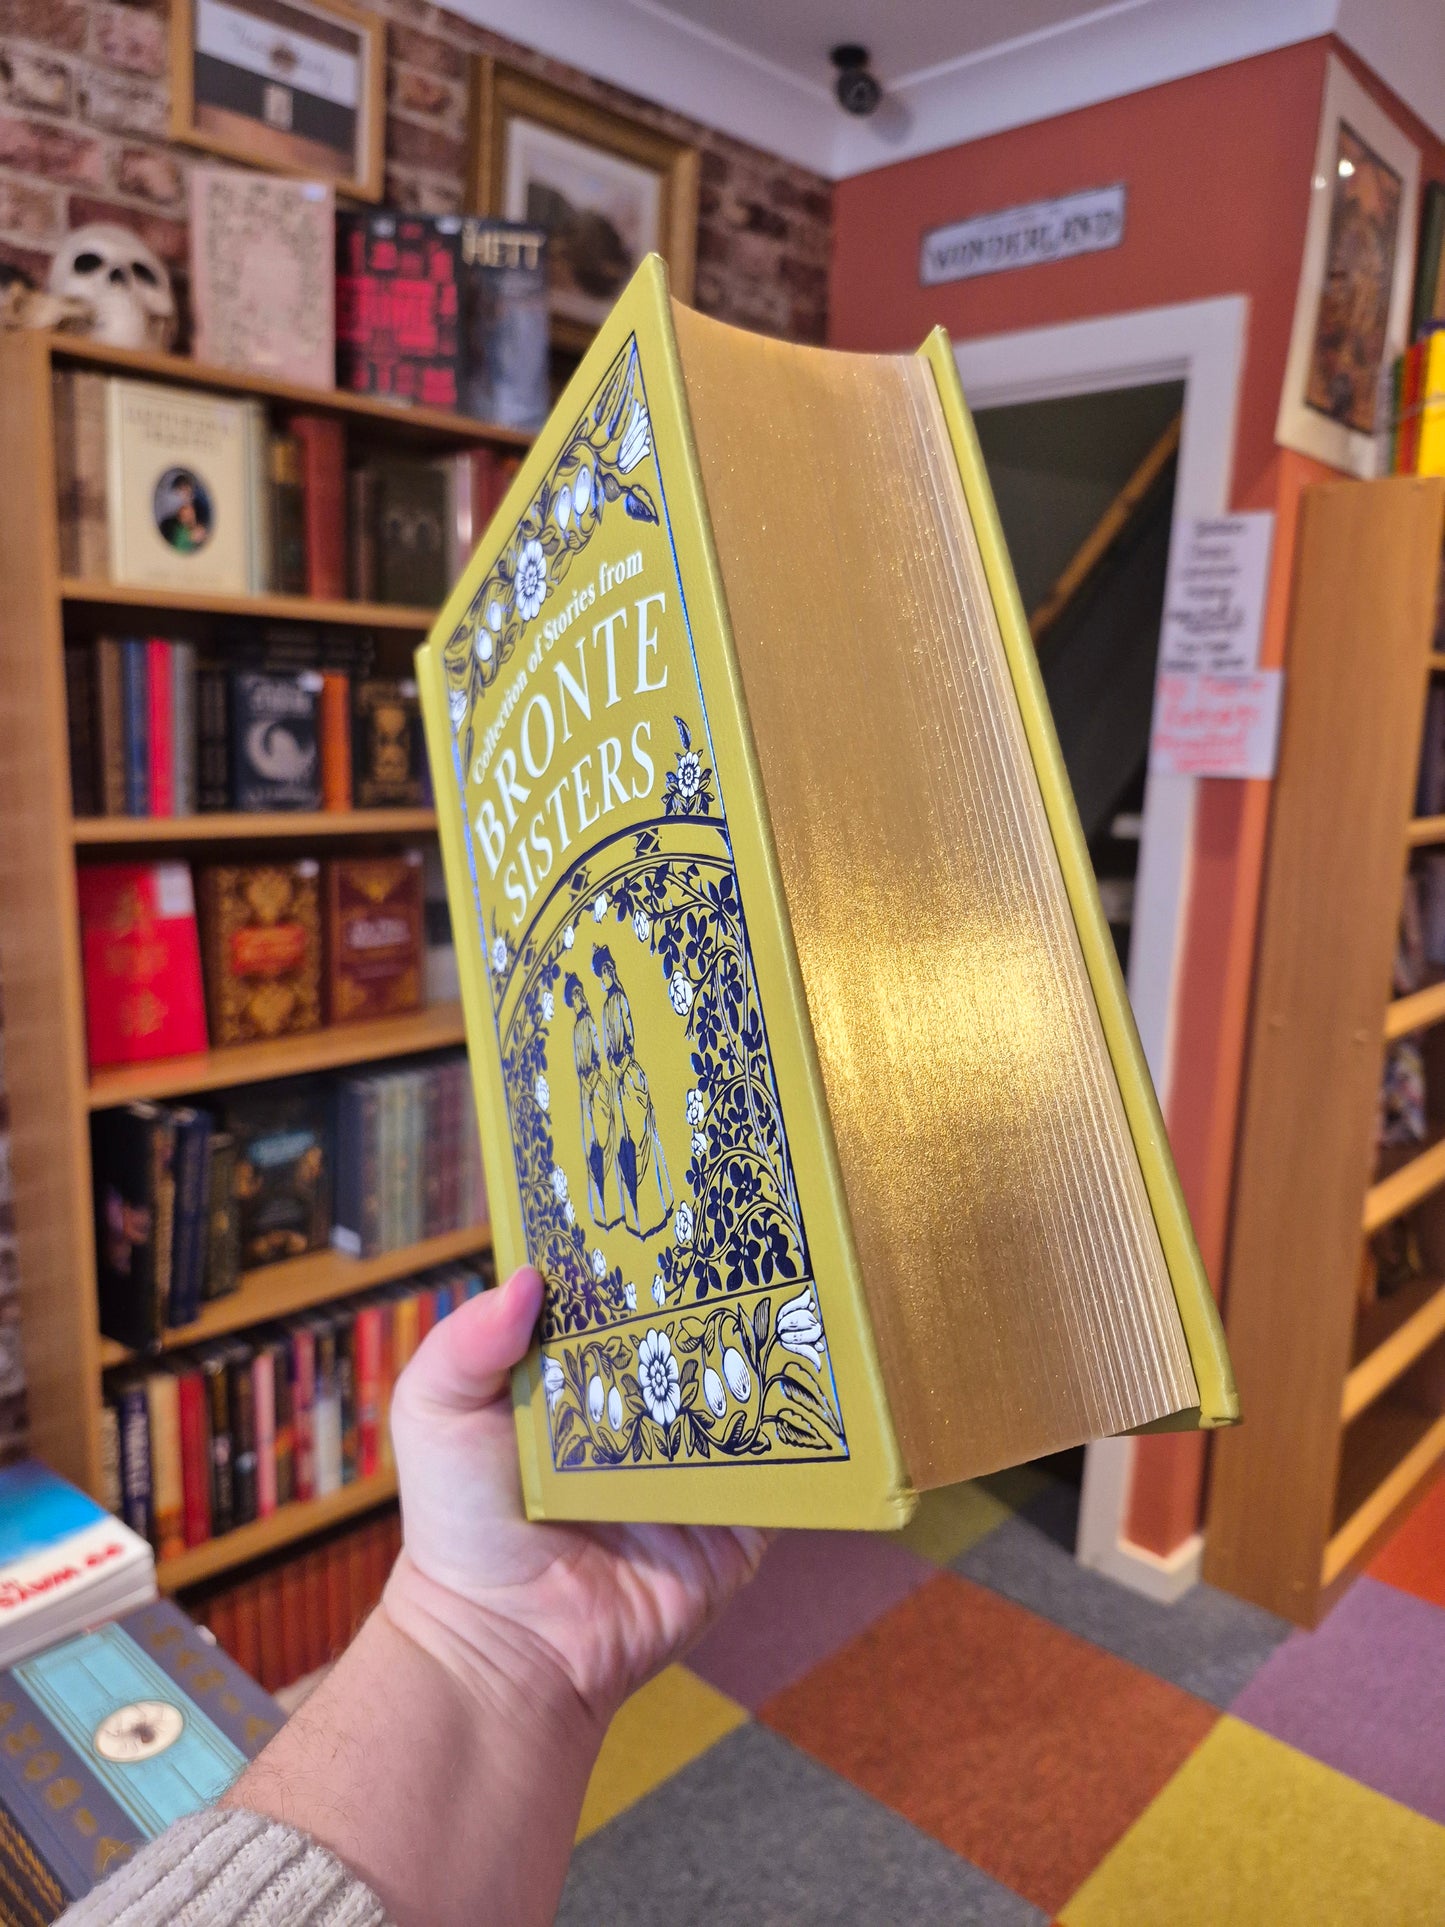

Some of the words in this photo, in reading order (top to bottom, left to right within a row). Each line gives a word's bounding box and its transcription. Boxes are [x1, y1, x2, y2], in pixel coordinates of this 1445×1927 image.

[472, 668, 528, 785] Collection
[527, 633, 544, 673] of
[542, 582, 596, 652] Stories
[598, 549, 644, 597] from
[475, 591, 669, 881] BRONTE
[503, 720, 655, 926] SISTERS
